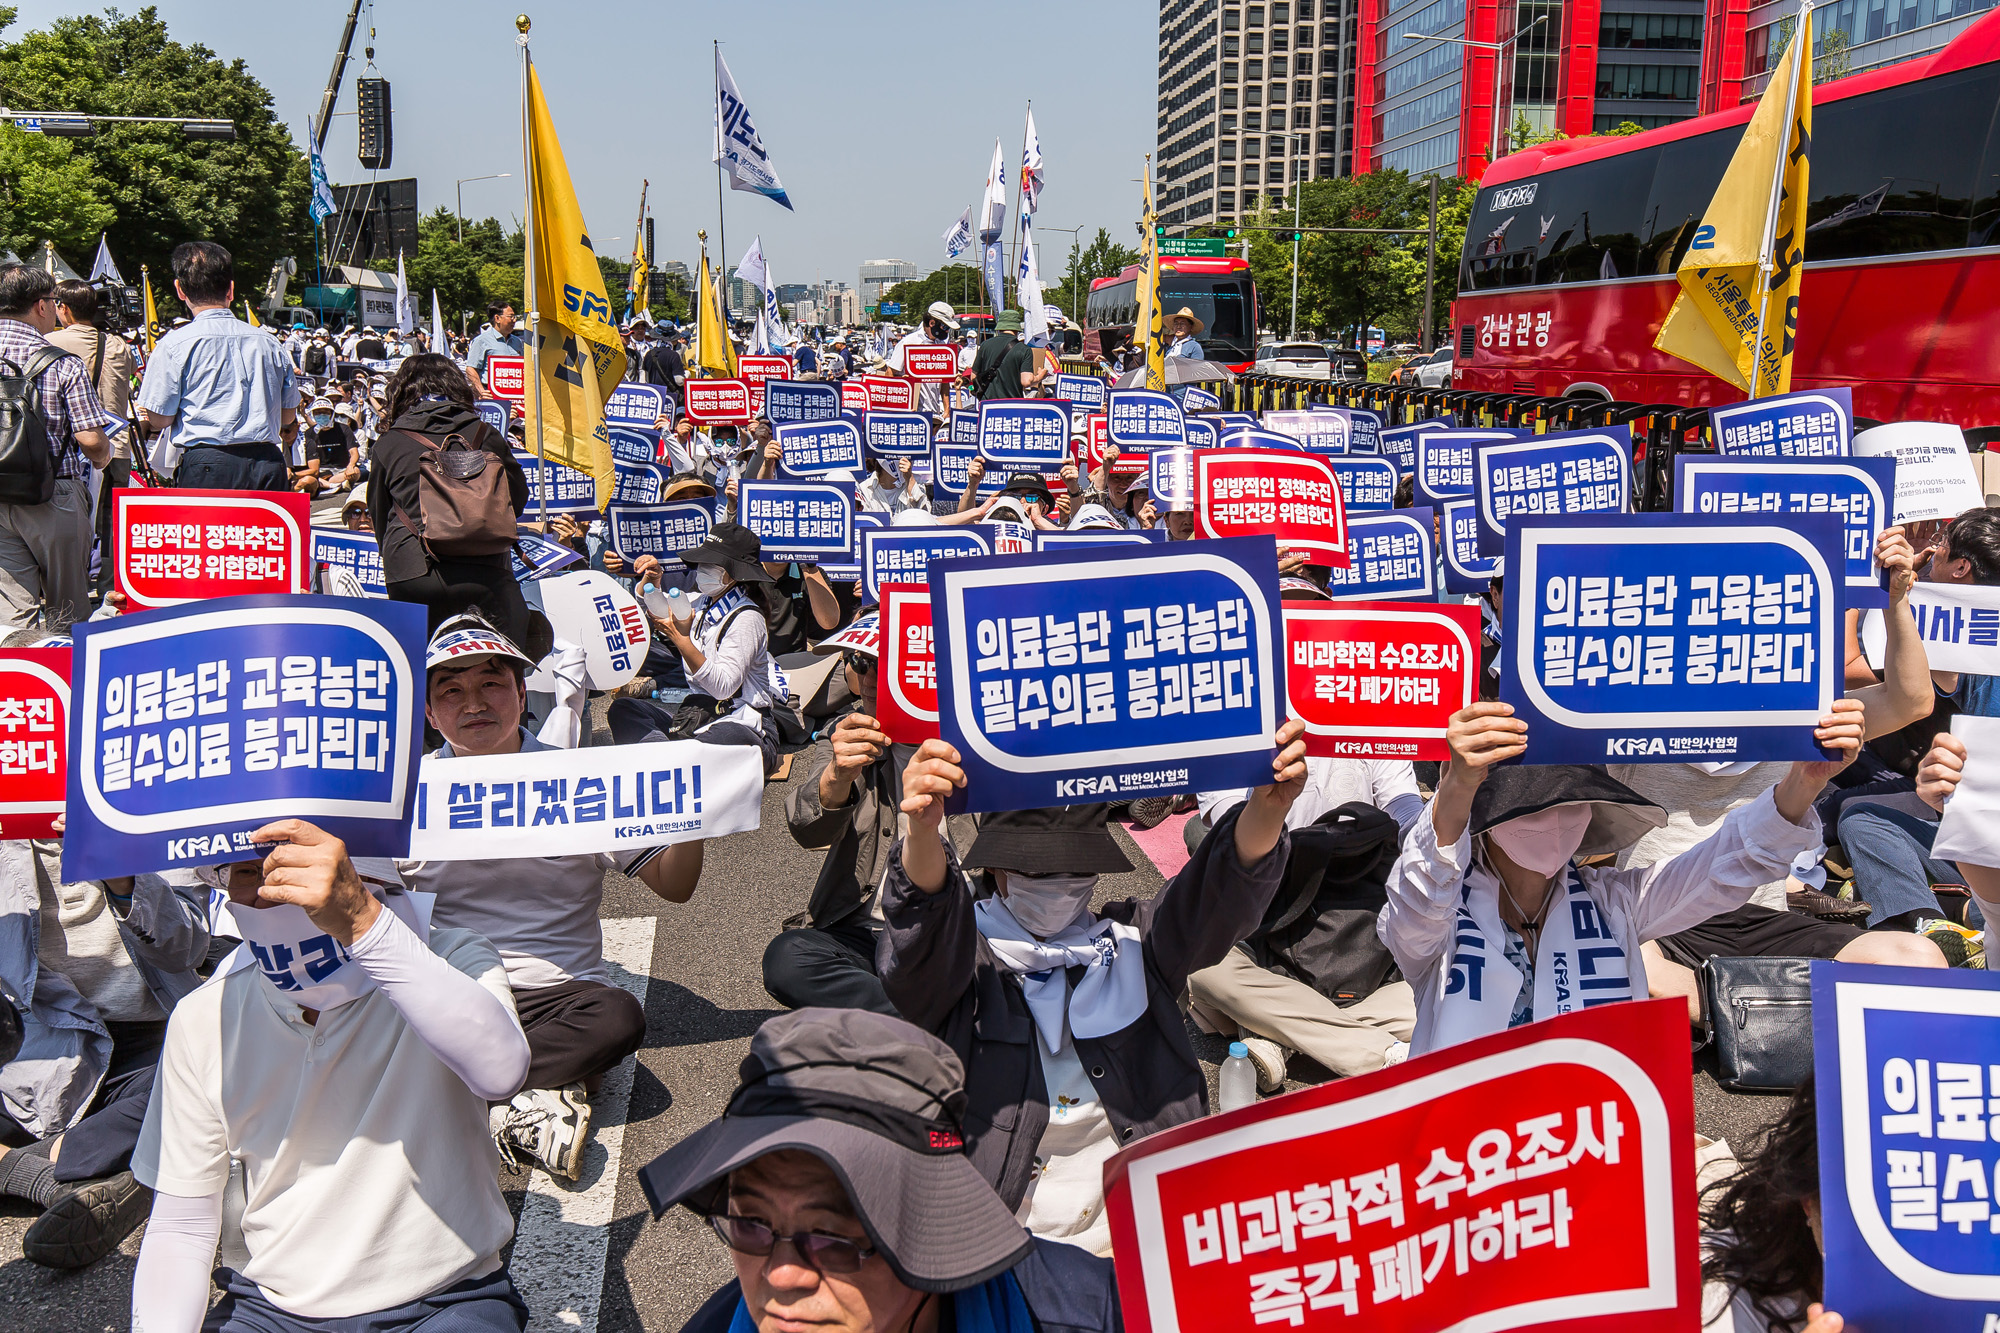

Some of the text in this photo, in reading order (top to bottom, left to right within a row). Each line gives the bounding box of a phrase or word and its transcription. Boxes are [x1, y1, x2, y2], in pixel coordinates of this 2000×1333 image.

[1705, 282, 1748, 340] SEOUL MEDICAL
[1481, 311, 1551, 347] 강남관광
[931, 353, 952, 362] 수요조사
[495, 367, 523, 378] 일방적인
[764, 365, 787, 374] 수요조사
[495, 378, 523, 389] 국민건강
[888, 386, 909, 395] 정책추진
[1061, 382, 1102, 393] 의료농단 교육농단
[629, 395, 658, 408] 교육농단
[692, 389, 744, 400] 일방적인 정책추진
[771, 392, 835, 407] 의료농단 교육농단
[887, 395, 909, 404] 위협한다
[1061, 391, 1101, 402] 필수의료 붕괴된다
[627, 407, 657, 421] 붕괴된다
[692, 400, 745, 411] 국민건강 위협한다
[771, 407, 835, 420] 필수의료 붕괴된다
[1114, 404, 1179, 421] 의료농단 교육농단
[871, 422, 925, 434] 의료농단 교육농단
[986, 417, 1062, 434] 의료농단 교육농단
[1114, 420, 1181, 436] 필수의료 붕괴된다
[1309, 421, 1343, 434] 교육농단
[1724, 411, 1837, 448] 의료농단 교육농단
[783, 431, 854, 451] 의료농단 교육농단
[871, 434, 926, 446] 필수의료 붕괴된다
[985, 434, 1062, 451] 필수의료 붕괴된다
[1309, 435, 1344, 448] 붕괴된다
[1385, 438, 1413, 454] 의료농단
[784, 447, 856, 467] 필수의료 붕괴된다
[1896, 446, 1956, 456] 투쟁기금 마련에
[622, 474, 658, 491] 교육농단
[1355, 471, 1391, 487] 교육농단
[1427, 468, 1474, 486] 필수의료
[1493, 455, 1619, 493] 의료농단 교육농단
[1900, 478, 1967, 489] 228-910015-16204
[556, 484, 594, 500] 붕괴된다
[621, 487, 657, 505] 붕괴된다
[1212, 477, 1332, 504] 일방적인 정책추진
[1355, 488, 1391, 503] 붕괴된다
[750, 499, 843, 519] 의료농단 교육농단
[1494, 482, 1620, 521] 필수의료 붕괴된다
[1212, 502, 1334, 527] 국민건강 위협한다
[620, 515, 705, 536] 의료농단 교육농단
[750, 519, 843, 538] 필수의료 붕괴된다
[130, 523, 286, 552] 일방적인 정책추진
[621, 536, 664, 553] 필수의료
[666, 533, 706, 551] 붕괴된다
[1362, 532, 1419, 557] 교육농단
[316, 544, 357, 565] 의료농단
[773, 553, 795, 561] KMA
[875, 549, 927, 571] 의료농단
[130, 553, 287, 581] 국민건강 위협한다
[1365, 558, 1422, 584] 붕괴된다
[1543, 574, 1815, 627] 의료농단 교육농단
[593, 593, 632, 673] 의료붕괴
[619, 604, 647, 646] 저지
[976, 610, 1112, 673] 의료농단
[1122, 598, 1250, 661] 교육농단
[1294, 641, 1460, 672] 비과학적 수요조사
[1543, 632, 1815, 687] 필수의료 붕괴된다
[103, 655, 391, 732] 의료농단 교육농단
[979, 671, 1118, 735] 필수의료
[1127, 658, 1256, 720] 붕괴된다
[1314, 674, 1441, 706] 즉각 폐기하라
[1334, 742, 1373, 755] KMA
[1374, 743, 1418, 752] 대한의사협회
[1606, 738, 1668, 756] KMA
[1668, 736, 1738, 749] 대한의사협회
[102, 715, 391, 794] 필수의료 붕괴된다
[1056, 775, 1118, 798] KMA
[1119, 768, 1189, 787] 대한의사협회
[1159, 780, 1189, 789] ASSOCIATION
[448, 765, 703, 830] 살리겠습니다!
[614, 819, 702, 839] KMA 대한의사협회
[167, 833, 232, 861] KMA
[235, 844, 257, 852] KOREAN
[1553, 951, 1572, 1003] KMA
[1882, 1056, 2000, 1143] 의료
[1182, 1100, 1625, 1268] 비과학적 수요조사
[1886, 1148, 2000, 1235] 필수
[1248, 1188, 1574, 1328] 즉각 폐기하라
